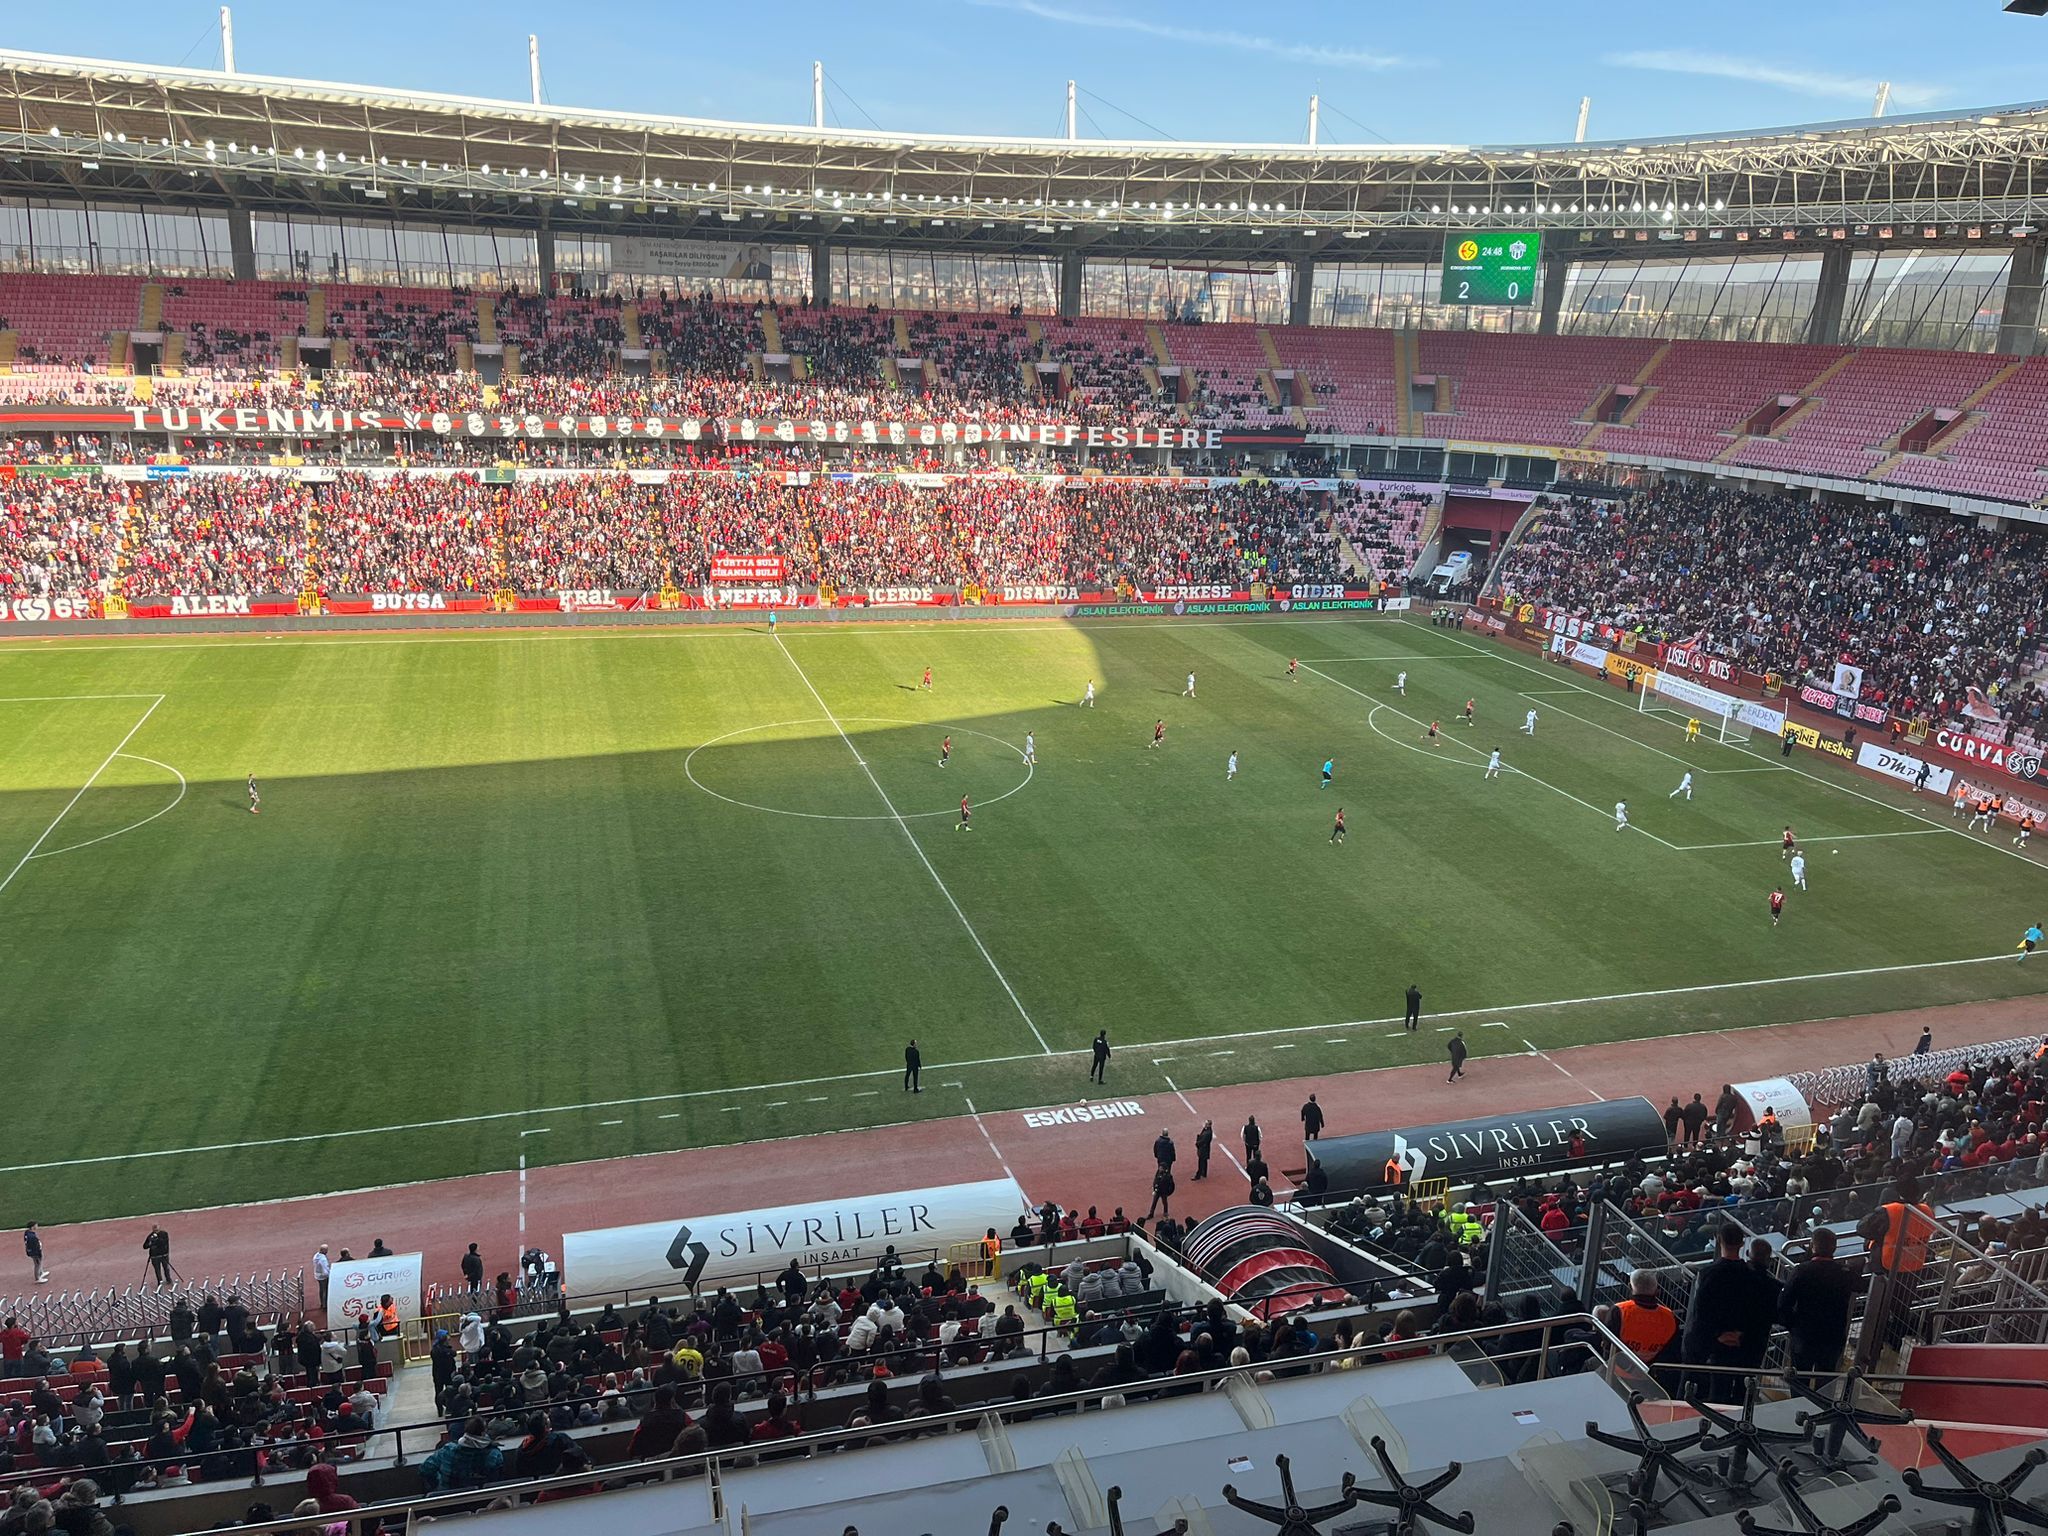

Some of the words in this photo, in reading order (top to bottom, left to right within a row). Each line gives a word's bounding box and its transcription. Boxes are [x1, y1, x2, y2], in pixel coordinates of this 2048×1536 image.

[1482, 247, 1502, 256] 24:48
[1458, 282, 1470, 298] 2
[1508, 282, 1518, 300] 0
[1010, 425, 1223, 450] NEFESLERE
[1380, 482, 1416, 492] turknet
[718, 588, 782, 604] NEFER
[1154, 586, 1232, 599] HERKESE
[1292, 584, 1345, 598] GİDER
[54, 599, 90, 618] 65
[170, 596, 249, 614] ALEM
[372, 594, 446, 610] BUYSA
[1077, 606, 1106, 616] ASLAN
[1109, 604, 1164, 614] ELEKTRONİK
[1186, 604, 1216, 612] ASLAN
[1218, 602, 1270, 612] ELEKTRONİK
[1292, 602, 1320, 610] ASLAN
[1322, 600, 1374, 609] ELEKTRONİK
[1544, 612, 1594, 637] 1965
[1818, 738, 1854, 760] NESİNE
[1936, 730, 2003, 766] CURVA
[1428, 1114, 1598, 1162] SİVRİLER
[1498, 1154, 1542, 1168] İNŞAAT
[720, 1204, 936, 1258] SİVRİLER
[804, 1248, 860, 1264] İNŞAAT
